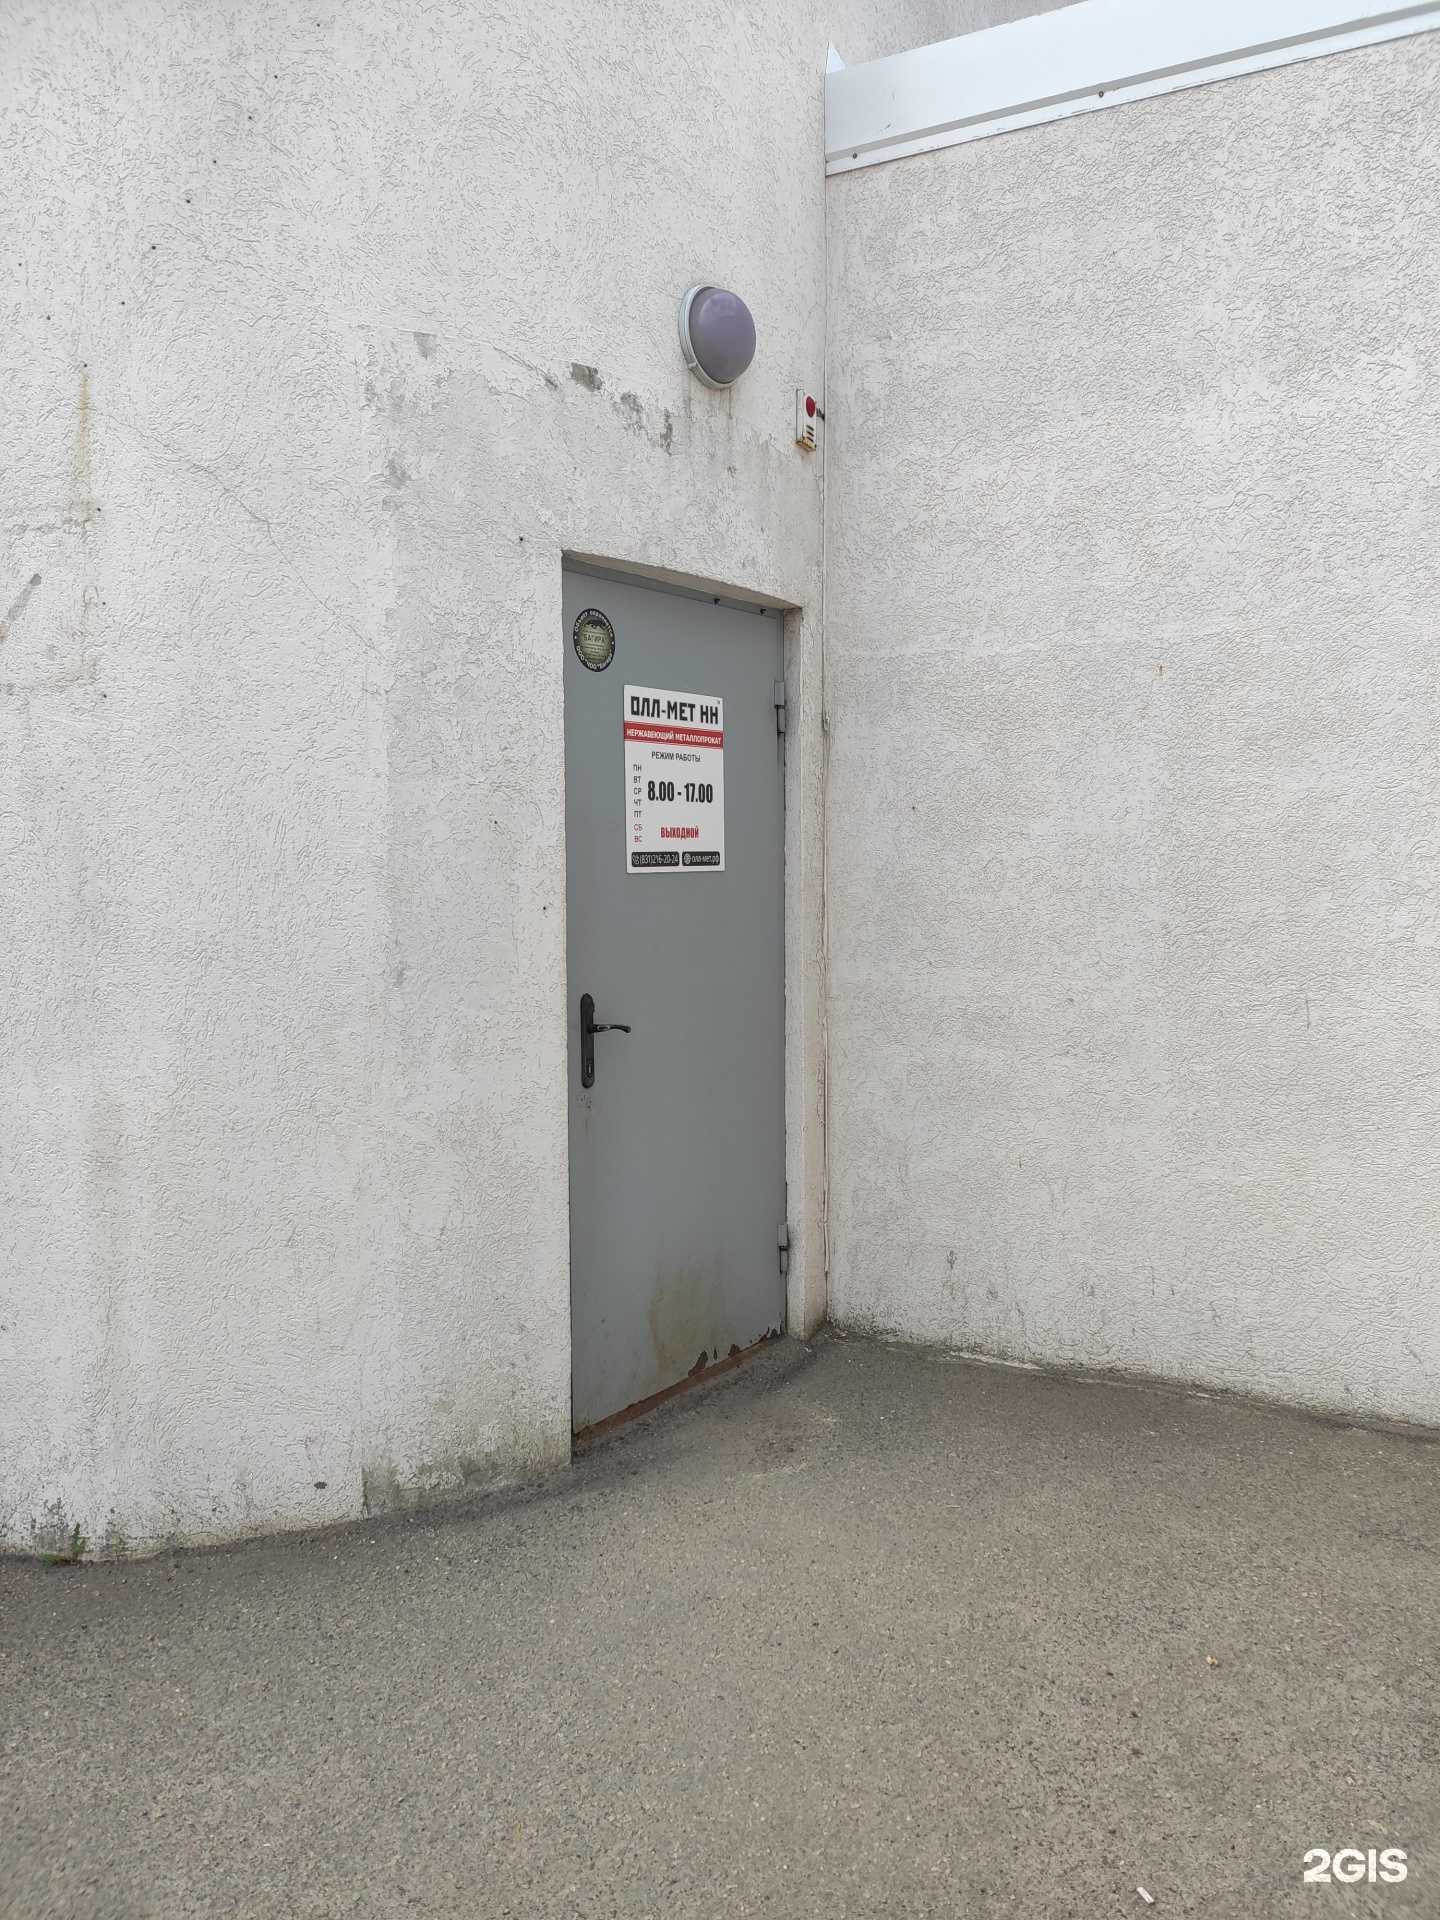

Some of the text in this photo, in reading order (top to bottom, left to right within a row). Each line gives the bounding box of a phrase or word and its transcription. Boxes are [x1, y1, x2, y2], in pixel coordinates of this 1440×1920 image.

[630, 695, 718, 725] ОЛЛ-МЕТ НН
[626, 728, 721, 745] НЕРЖАВЕЮЩИЙ МЕТАЛЛОПРОКАТ
[651, 751, 701, 763] РЕЖИМ РАБОТЫ
[633, 763, 642, 772] ПН
[633, 775, 641, 784] ВТ
[633, 787, 642, 795] СР
[647, 780, 675, 802] 8.00
[684, 782, 713, 803] 17.00
[633, 799, 641, 807] ЧТ
[633, 810, 642, 818] ПТ
[633, 823, 642, 832] СБ
[660, 825, 699, 840] ВЫХОДНОЙ
[634, 835, 642, 843] ВС
